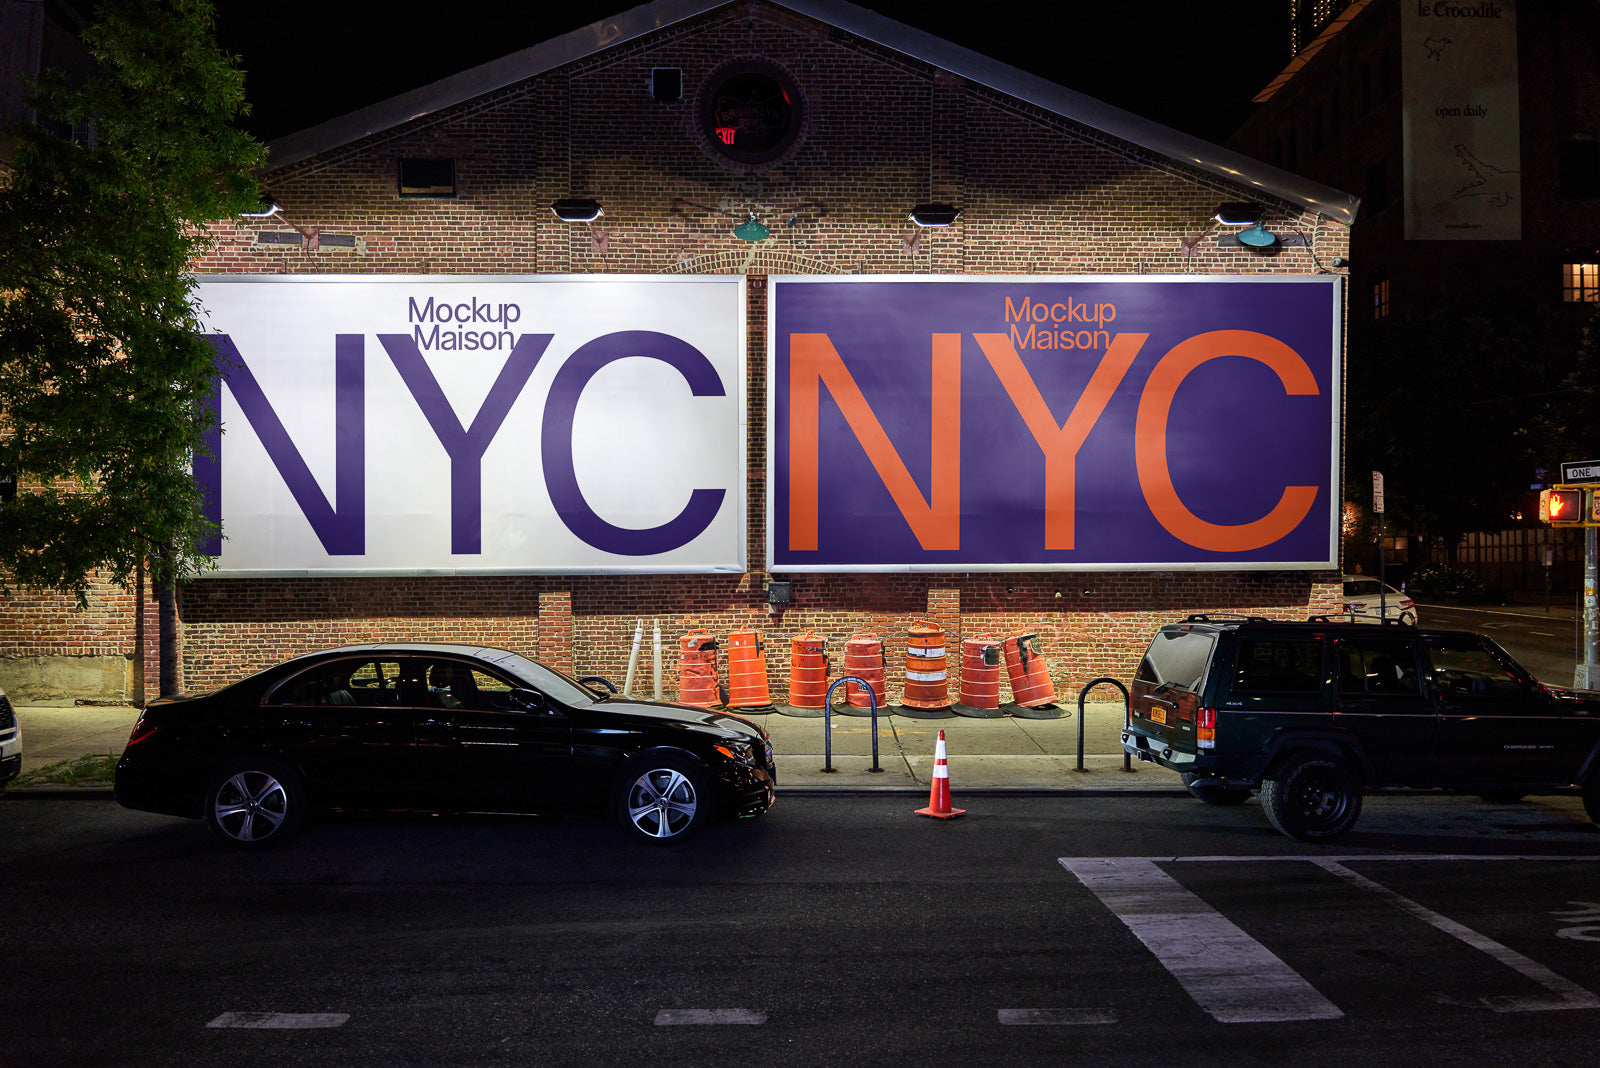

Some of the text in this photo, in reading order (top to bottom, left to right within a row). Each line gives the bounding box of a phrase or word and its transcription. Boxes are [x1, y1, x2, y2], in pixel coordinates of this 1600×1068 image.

[1418, 0, 1502, 18] le Crocodile
[1435, 104, 1488, 119] open daily
[408, 296, 520, 329] Mockup
[1005, 296, 1117, 329] Mockup
[414, 324, 515, 351] Maison
[1010, 323, 1110, 350] Maison
[192, 330, 726, 557] NYC
[789, 329, 1320, 553] NYC
[1571, 468, 1592, 478] ONE
